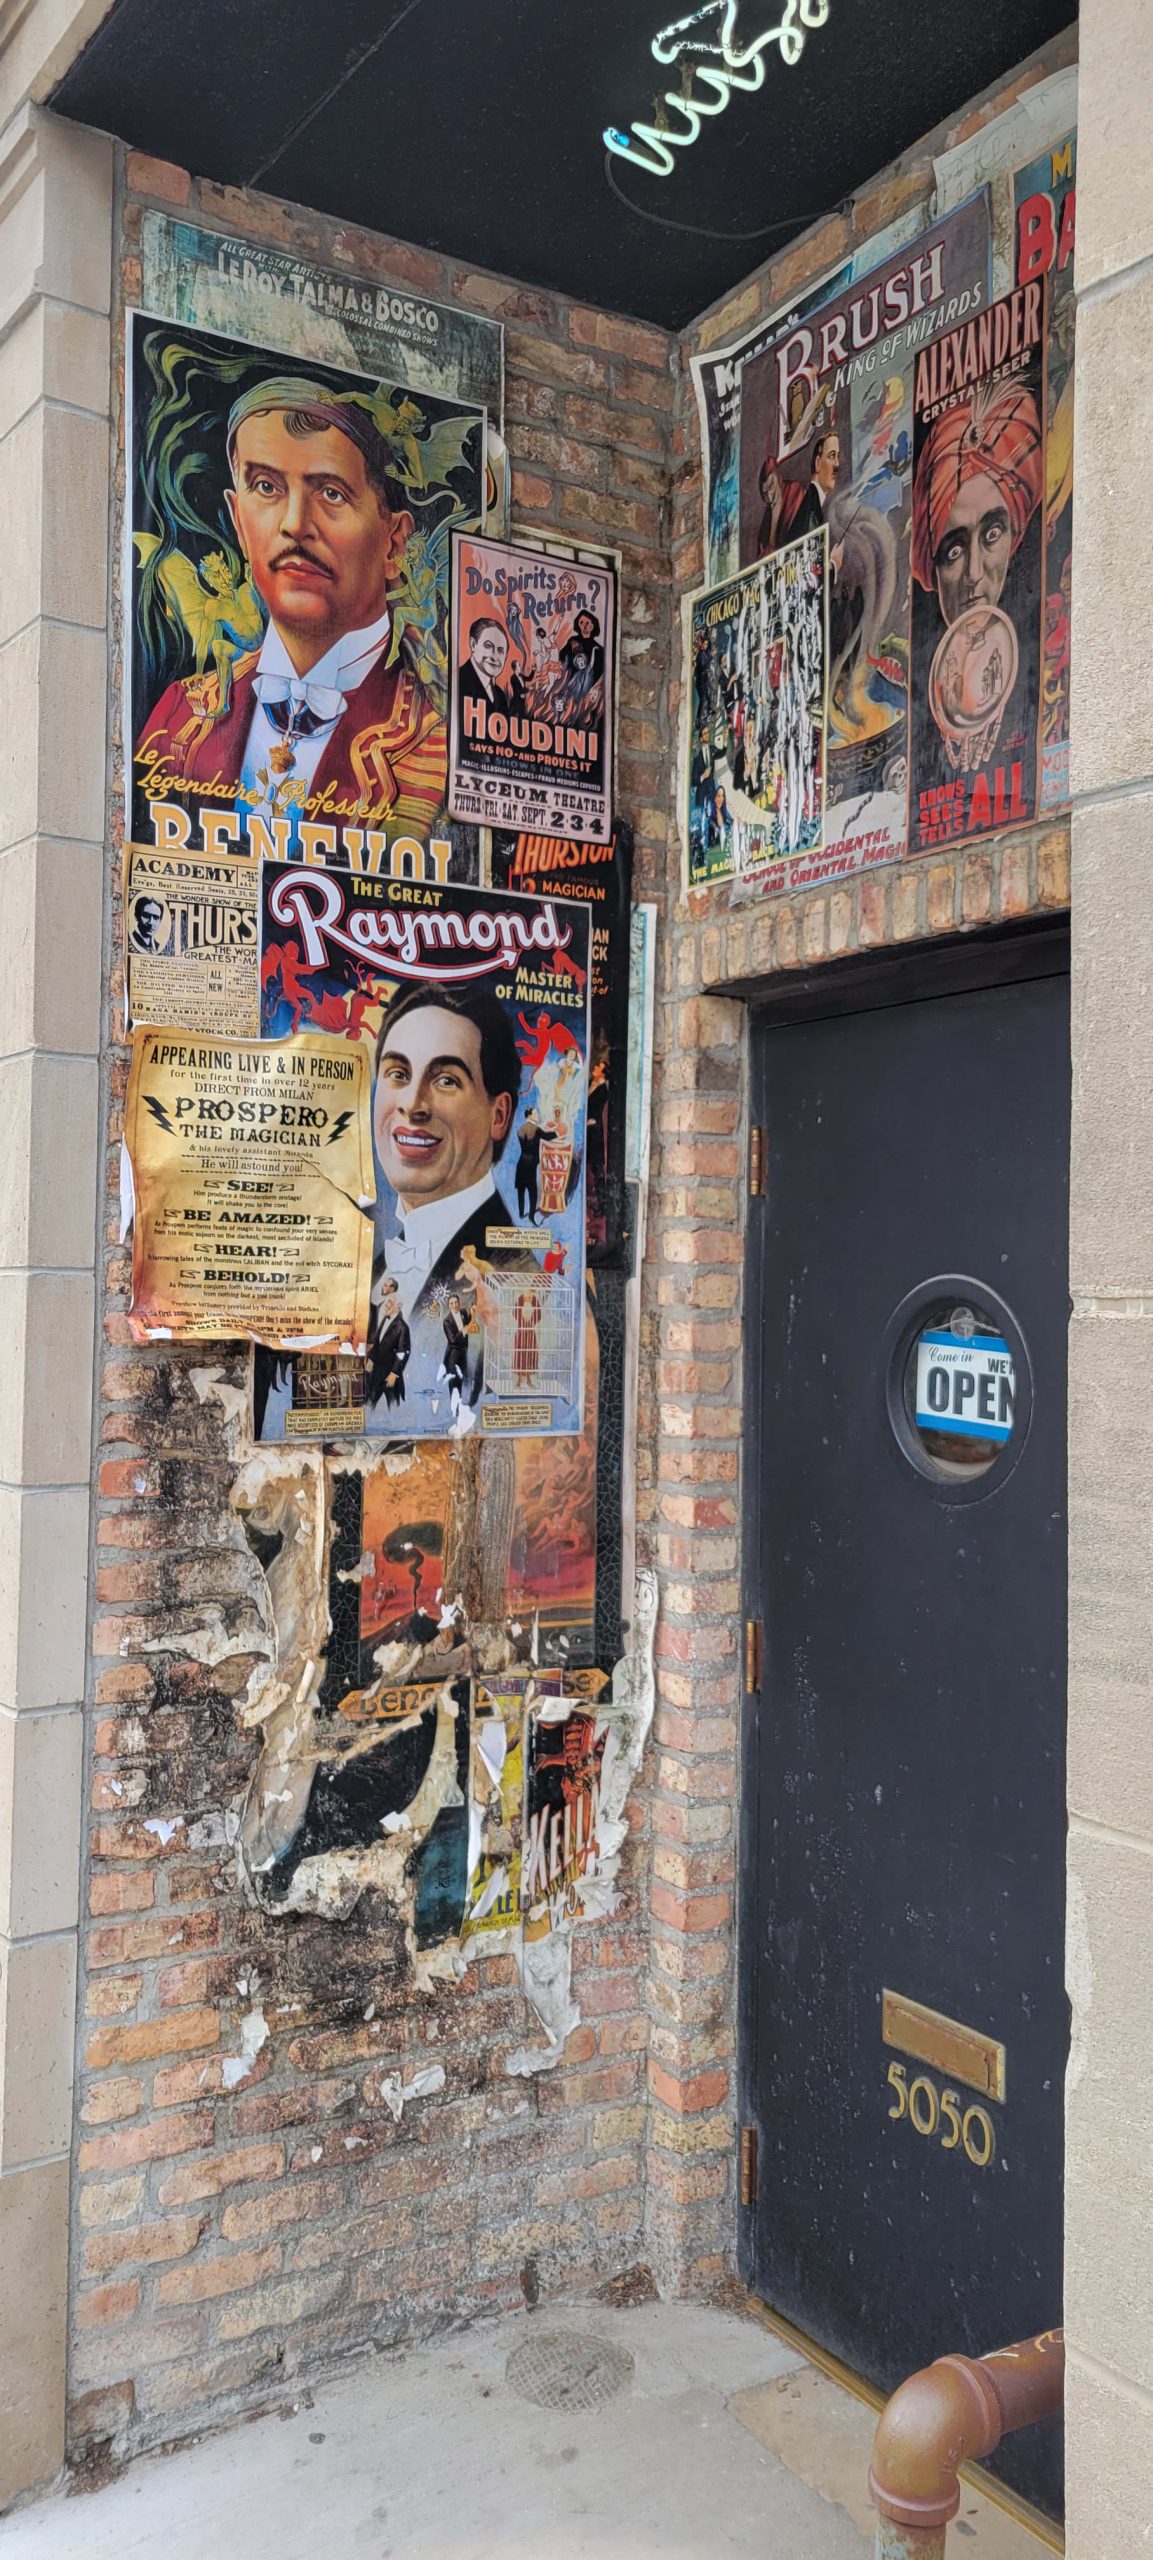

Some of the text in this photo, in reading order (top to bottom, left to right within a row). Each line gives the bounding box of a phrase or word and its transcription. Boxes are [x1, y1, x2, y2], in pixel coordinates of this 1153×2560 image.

[220, 242, 237, 255] ALL
[239, 246, 269, 262] GREAT
[269, 256, 292, 272] STAR
[289, 273, 359, 311] TALMA
[361, 291, 373, 315] &
[376, 290, 439, 333] BOSCO
[411, 333, 439, 348] SHOWS
[834, 351, 876, 391] KING
[906, 280, 983, 349] WIZARDS
[914, 281, 1042, 413] ALEXANDER
[776, 240, 945, 463] BRUSH
[465, 565, 557, 604] Do Spirits
[463, 695, 599, 761] HOUDINI
[133, 730, 169, 765] Le
[469, 742, 494, 754] SAYS
[518, 752, 536, 763] AND
[537, 753, 578, 771] PROVES
[579, 761, 592, 773] IT
[137, 756, 398, 822] Légendaire Professeur
[455, 774, 549, 804] LYCEUM
[553, 792, 605, 815] THEATRE
[919, 779, 966, 809] KNOWS
[967, 760, 1028, 832] ALL
[919, 799, 964, 829] SEES
[919, 817, 964, 847] TELLS
[134, 857, 236, 884] ACADEMY
[762, 877, 785, 895] AND
[790, 855, 857, 887] ORIENTAL
[158, 881, 172, 889] Best
[351, 877, 444, 907] THE GREAT
[542, 880, 606, 901] MAGICIAN
[180, 894, 209, 904] WONDER
[212, 897, 232, 906] SHOW
[270, 868, 573, 981] Raymond
[184, 951, 239, 964] GREATEST
[214, 945, 232, 955] THE
[210, 970, 223, 980] ALL
[516, 966, 573, 990] MASTER
[208, 983, 223, 993] NEW
[496, 985, 584, 1008] OF MIRACLES
[150, 1045, 355, 1081] APPEARING LIVE & IN PERSON
[170, 1069, 336, 1092] for the first time in over 12 years
[195, 1082, 315, 1101] DIRECT FROM MILAN
[174, 1096, 330, 1129] PROSPERO
[179, 1123, 322, 1148] THE MAGICIAN
[189, 1144, 282, 1157] & his lovely assistant
[201, 1157, 303, 1175] He will astound you!
[207, 1191, 233, 1199] produce
[227, 1179, 275, 1193] SEE!
[183, 1209, 312, 1226] BE AMAZED!
[187, 1222, 212, 1230] performs
[195, 1230, 216, 1239] sojourn
[213, 1257, 242, 1265] monstrous
[214, 1244, 278, 1258] HEAR!
[177, 1282, 203, 1290] Prospero
[203, 1283, 228, 1291] conjures
[203, 1269, 290, 1284] BEHOLD!
[217, 1292, 240, 1300] nothing
[240, 1292, 251, 1300] but
[928, 1346, 975, 1364] Come in
[887, 2060, 996, 2168] 5050
